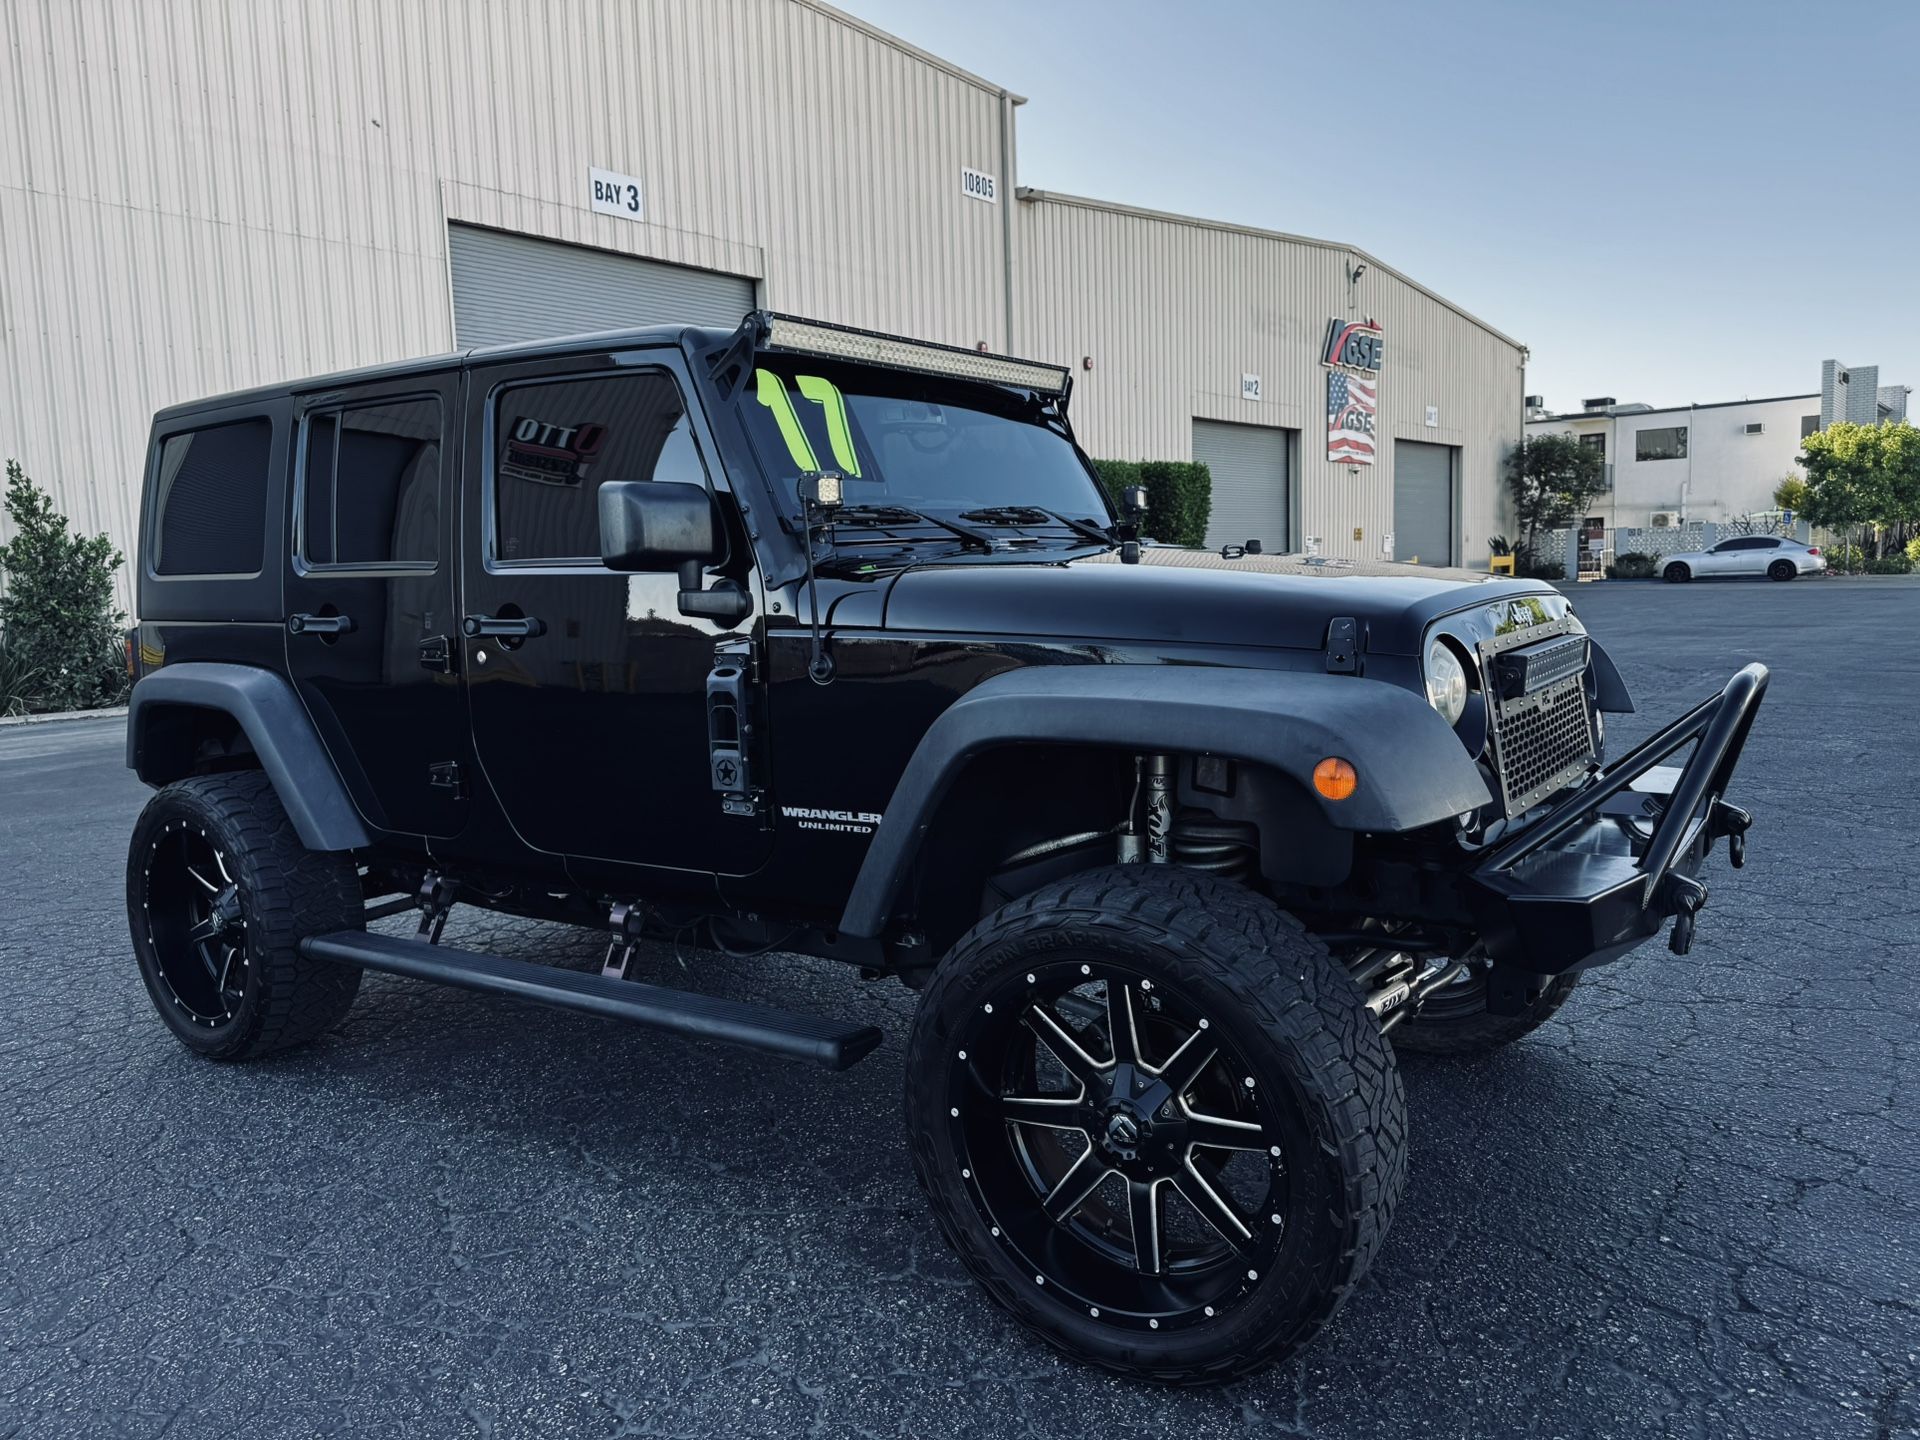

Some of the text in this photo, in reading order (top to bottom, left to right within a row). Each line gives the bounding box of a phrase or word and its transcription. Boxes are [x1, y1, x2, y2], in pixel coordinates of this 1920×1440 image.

[593, 180, 640, 213] BAY 3
[963, 171, 995, 199] 10805
[1254, 380, 1259, 395] 2
[756, 368, 862, 478] 17
[781, 806, 882, 824] WRANGLER
[798, 820, 872, 833] UNLIMITED
